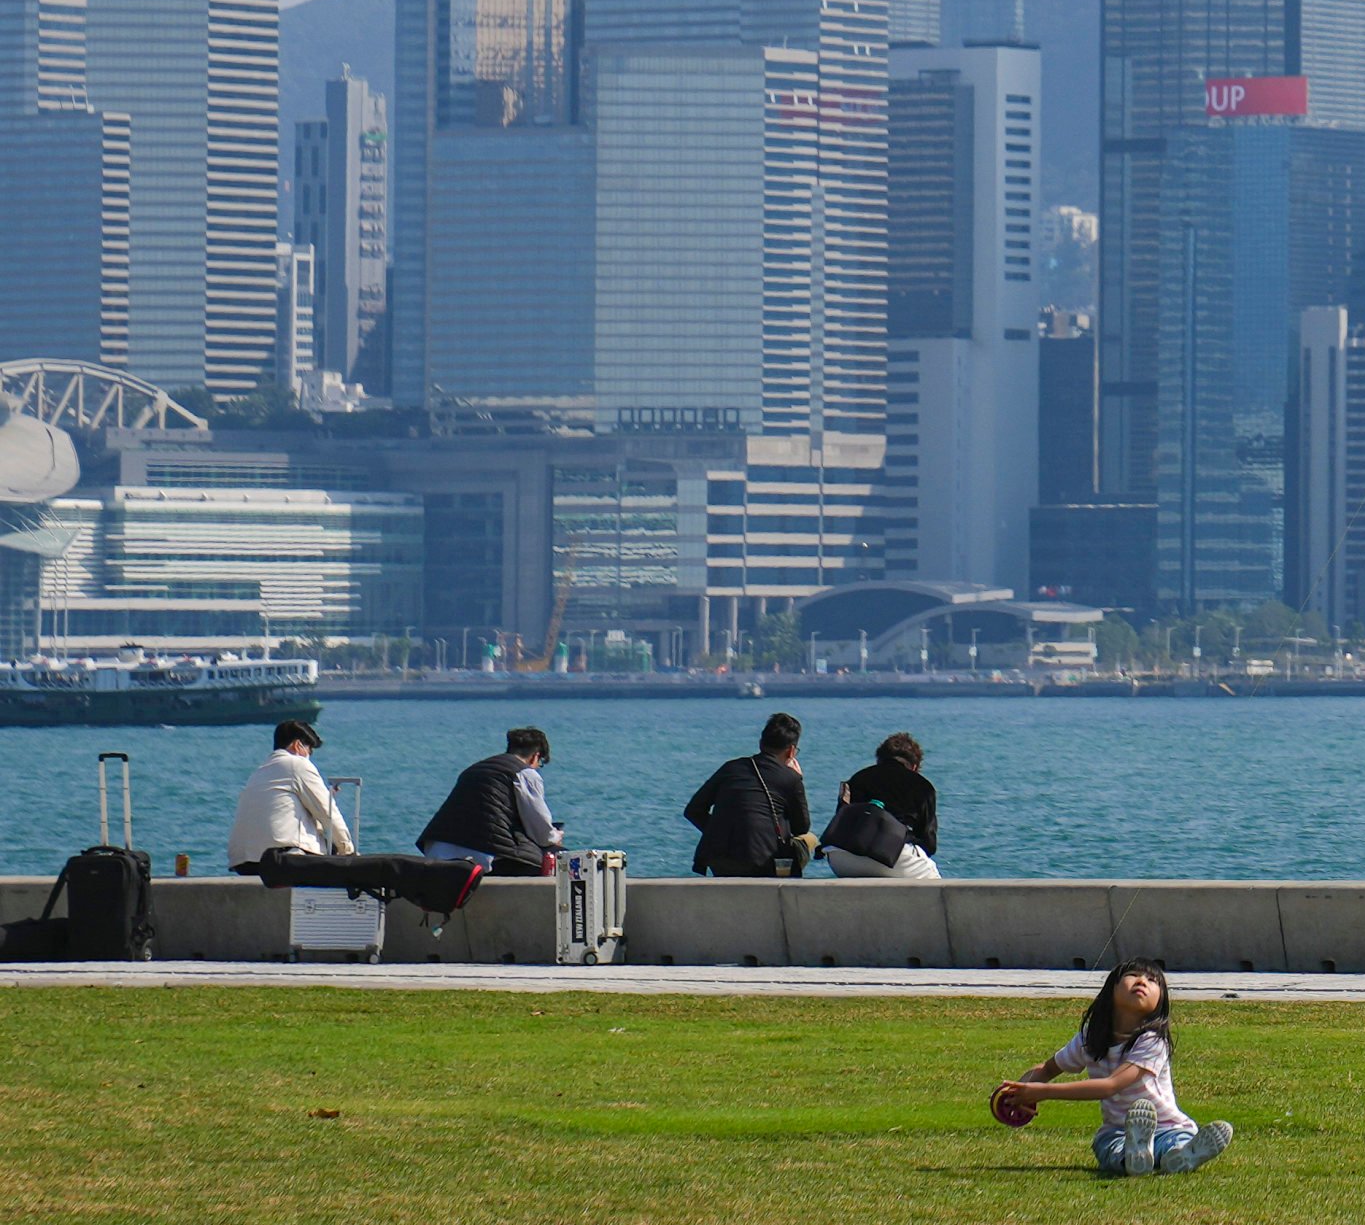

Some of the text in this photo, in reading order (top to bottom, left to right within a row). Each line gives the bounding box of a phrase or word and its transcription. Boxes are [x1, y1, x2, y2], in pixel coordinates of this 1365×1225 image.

[1205, 84, 1246, 112] UP
[574, 895, 584, 939] NEW ZEALAND
